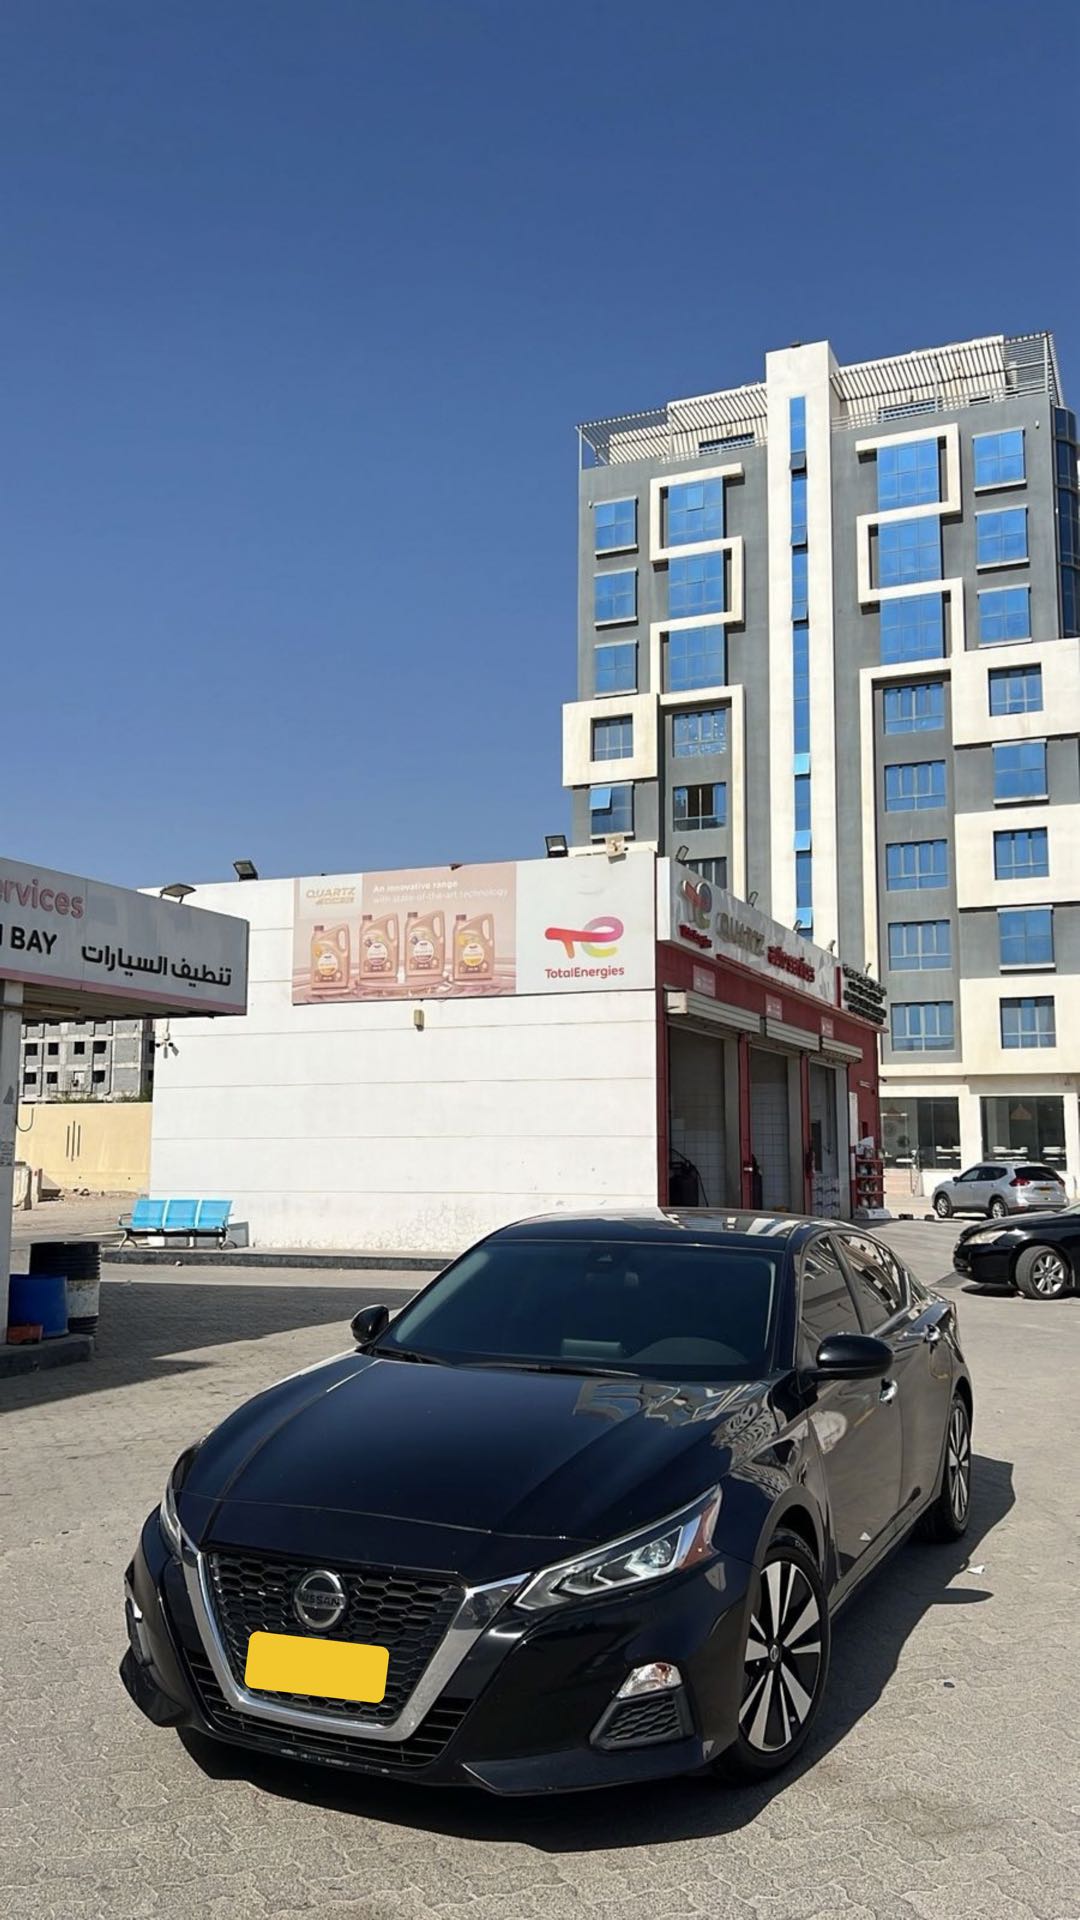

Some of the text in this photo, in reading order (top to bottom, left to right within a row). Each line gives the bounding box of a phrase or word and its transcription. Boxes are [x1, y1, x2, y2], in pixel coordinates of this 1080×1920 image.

[306, 887, 357, 898] QUARTZ
[10, 926, 57, 955] BAY
[81, 945, 168, 976] السيارات
[545, 965, 624, 979] TotalEnergies
[299, 1593, 340, 1607] NISSAN
